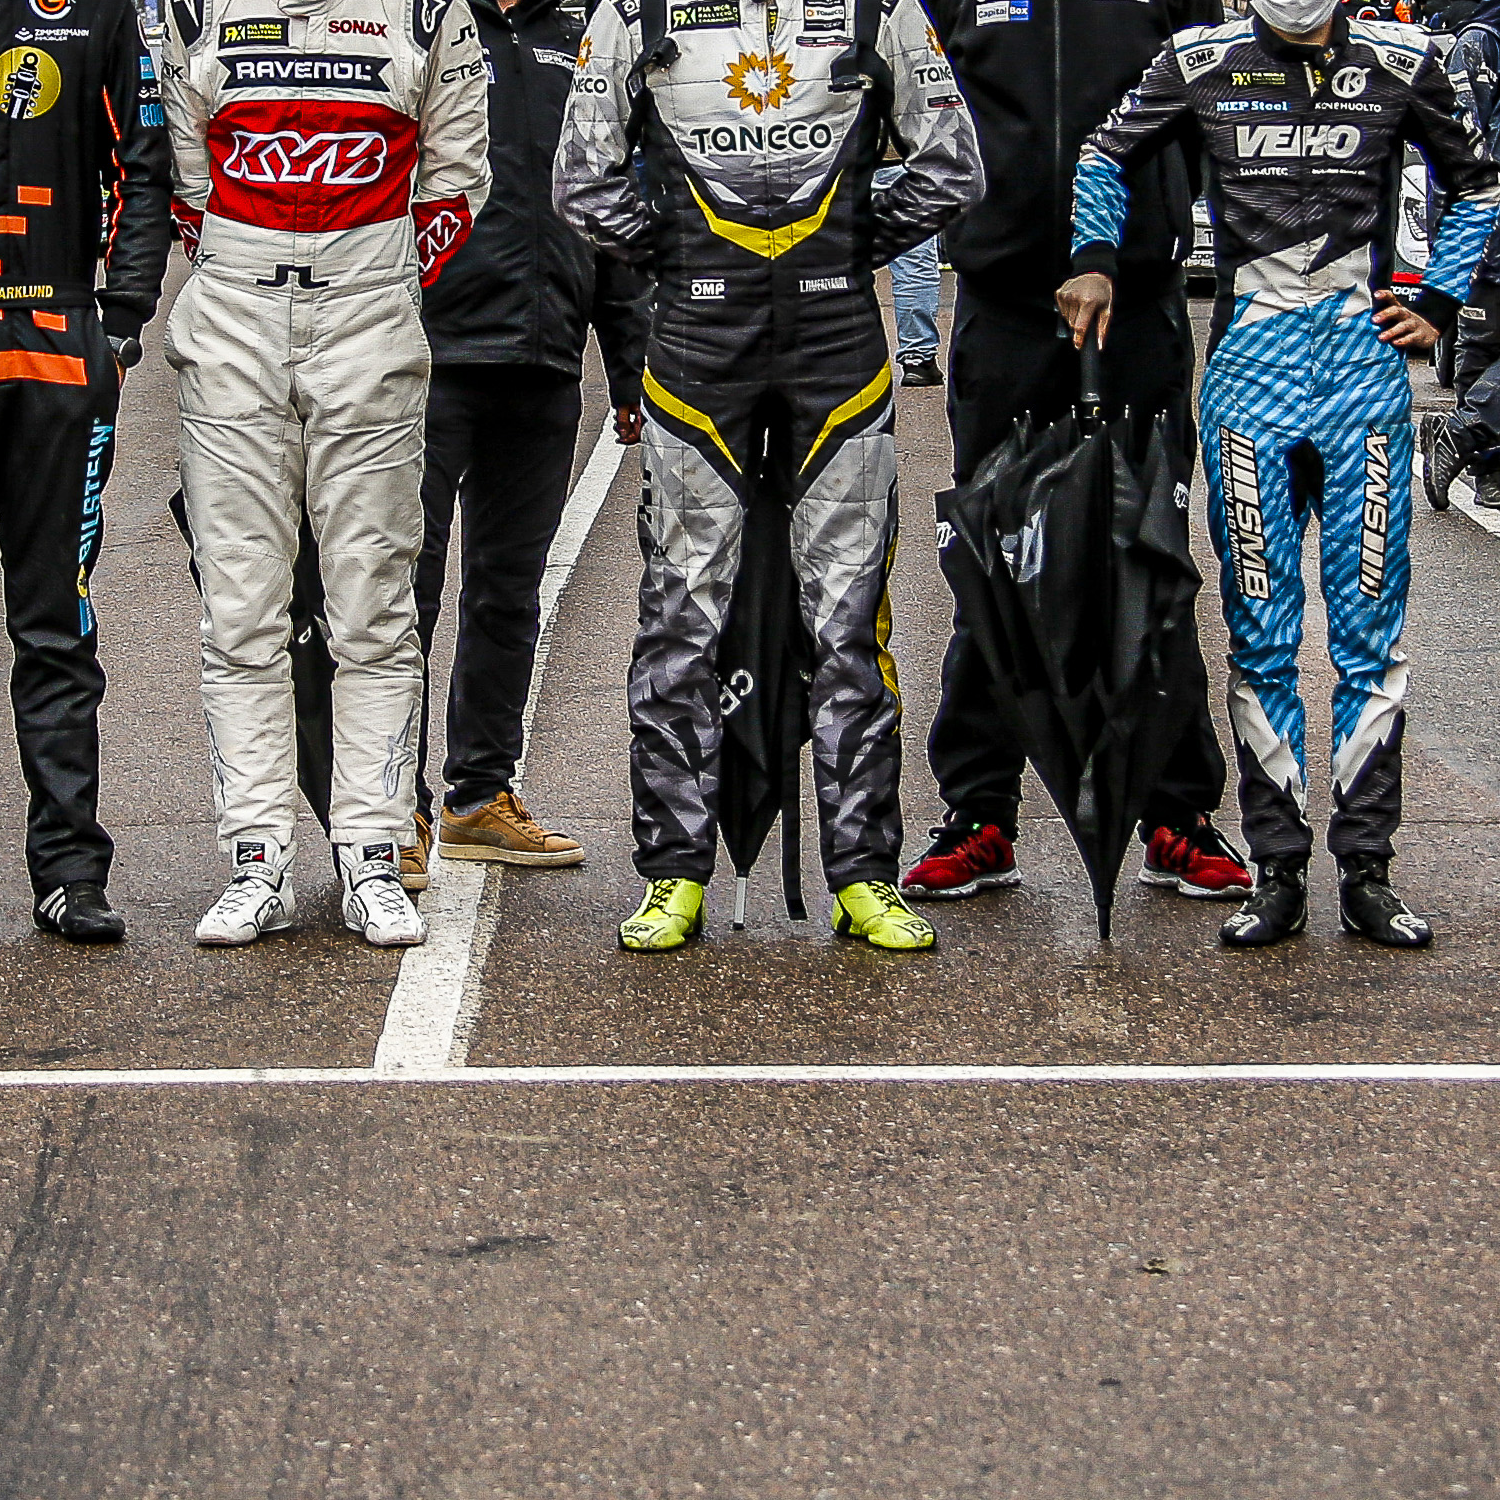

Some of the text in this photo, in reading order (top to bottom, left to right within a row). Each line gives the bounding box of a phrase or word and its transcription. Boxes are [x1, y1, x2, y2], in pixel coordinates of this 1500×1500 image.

[977, 6, 1029, 19] Capital Box
[34, 28, 90, 37] ZIMMERMANN
[328, 19, 388, 39] SONAX
[1185, 50, 1215, 68] OMP
[1386, 53, 1415, 70] OMP
[236, 60, 372, 81] RAVENOL
[1216, 100, 1250, 112] MEP
[690, 124, 832, 155] TANECO
[222, 130, 388, 186] KYB
[691, 282, 725, 296] OMP
[1221, 427, 1234, 499] SWEDEN
[78, 423, 114, 564] BILSTEIN
[1236, 502, 1271, 599] SMB
